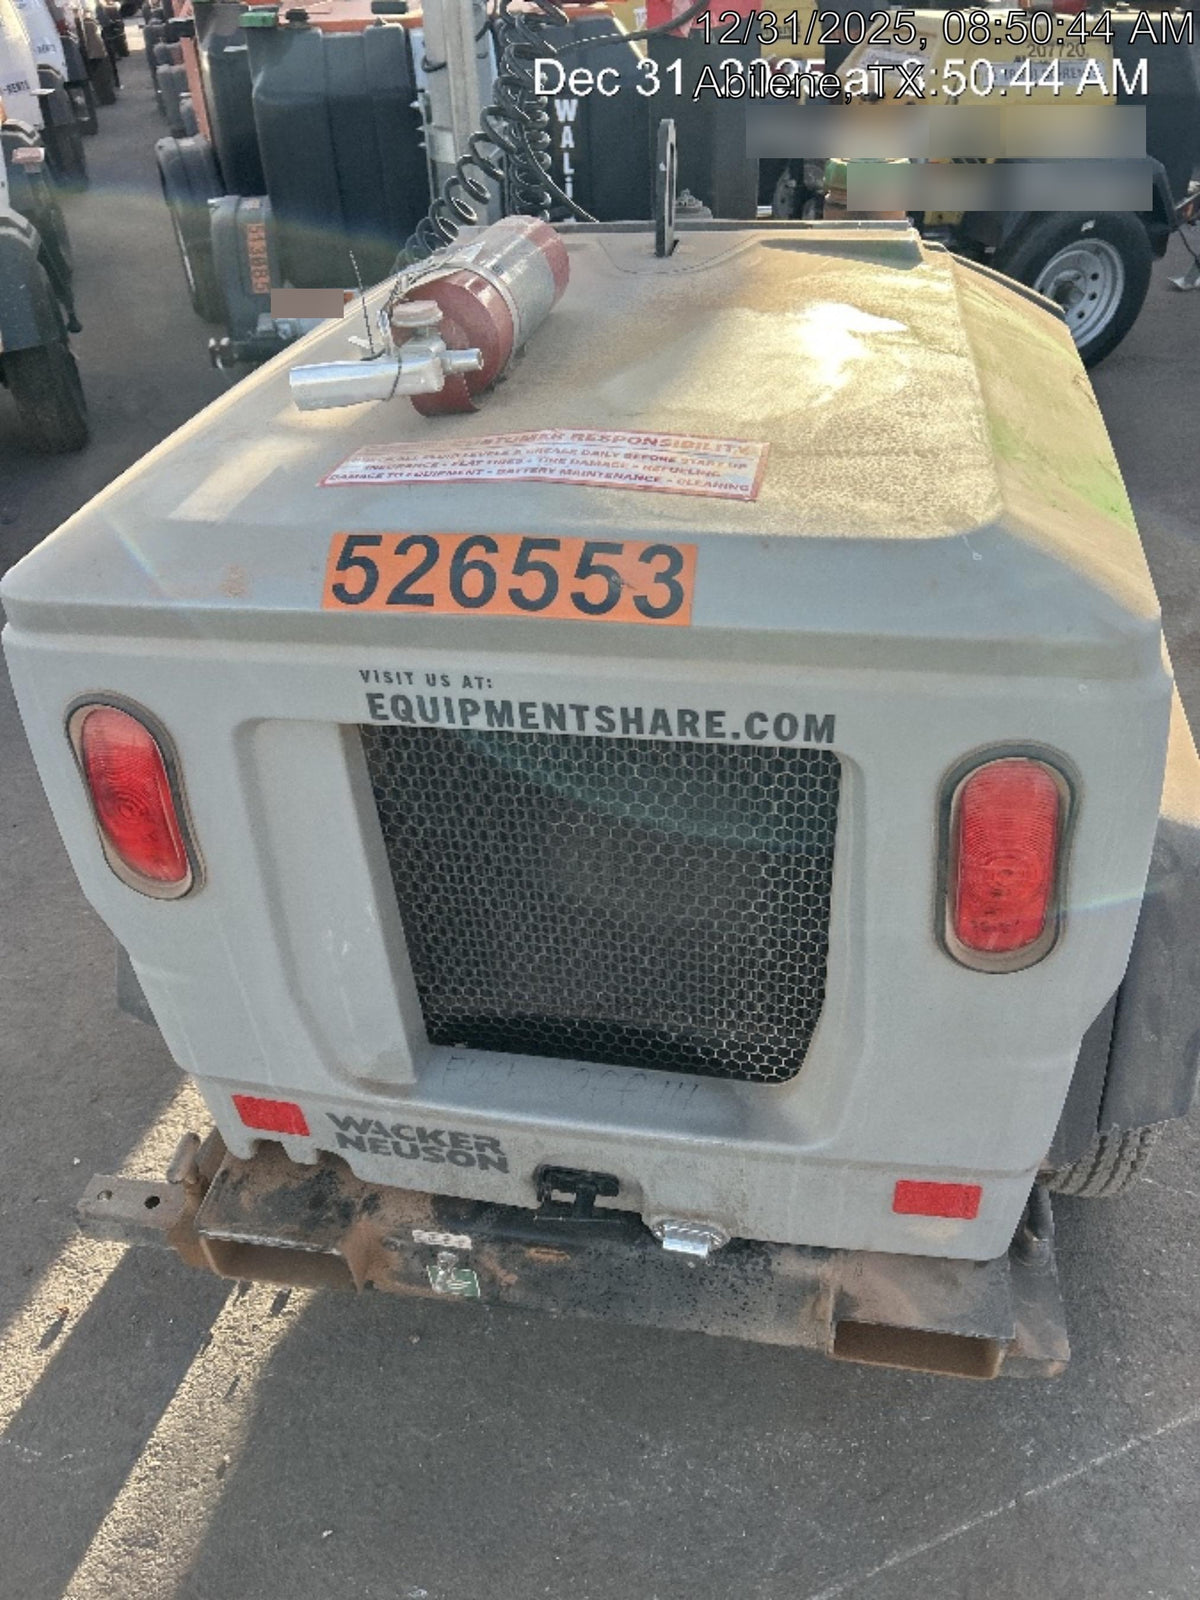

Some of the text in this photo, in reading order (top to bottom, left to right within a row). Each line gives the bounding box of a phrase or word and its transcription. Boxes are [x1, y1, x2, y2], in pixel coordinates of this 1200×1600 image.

[570, 433, 751, 456] RESPONSIBILITY
[558, 468, 661, 484] MAINTENANCE
[331, 533, 685, 620] 526553
[359, 669, 493, 690] VISIT US AT:
[365, 692, 837, 745] EQUIPMENTSHARE.COM
[325, 1112, 506, 1156] WACKER
[335, 1132, 510, 1174] NEUSON
